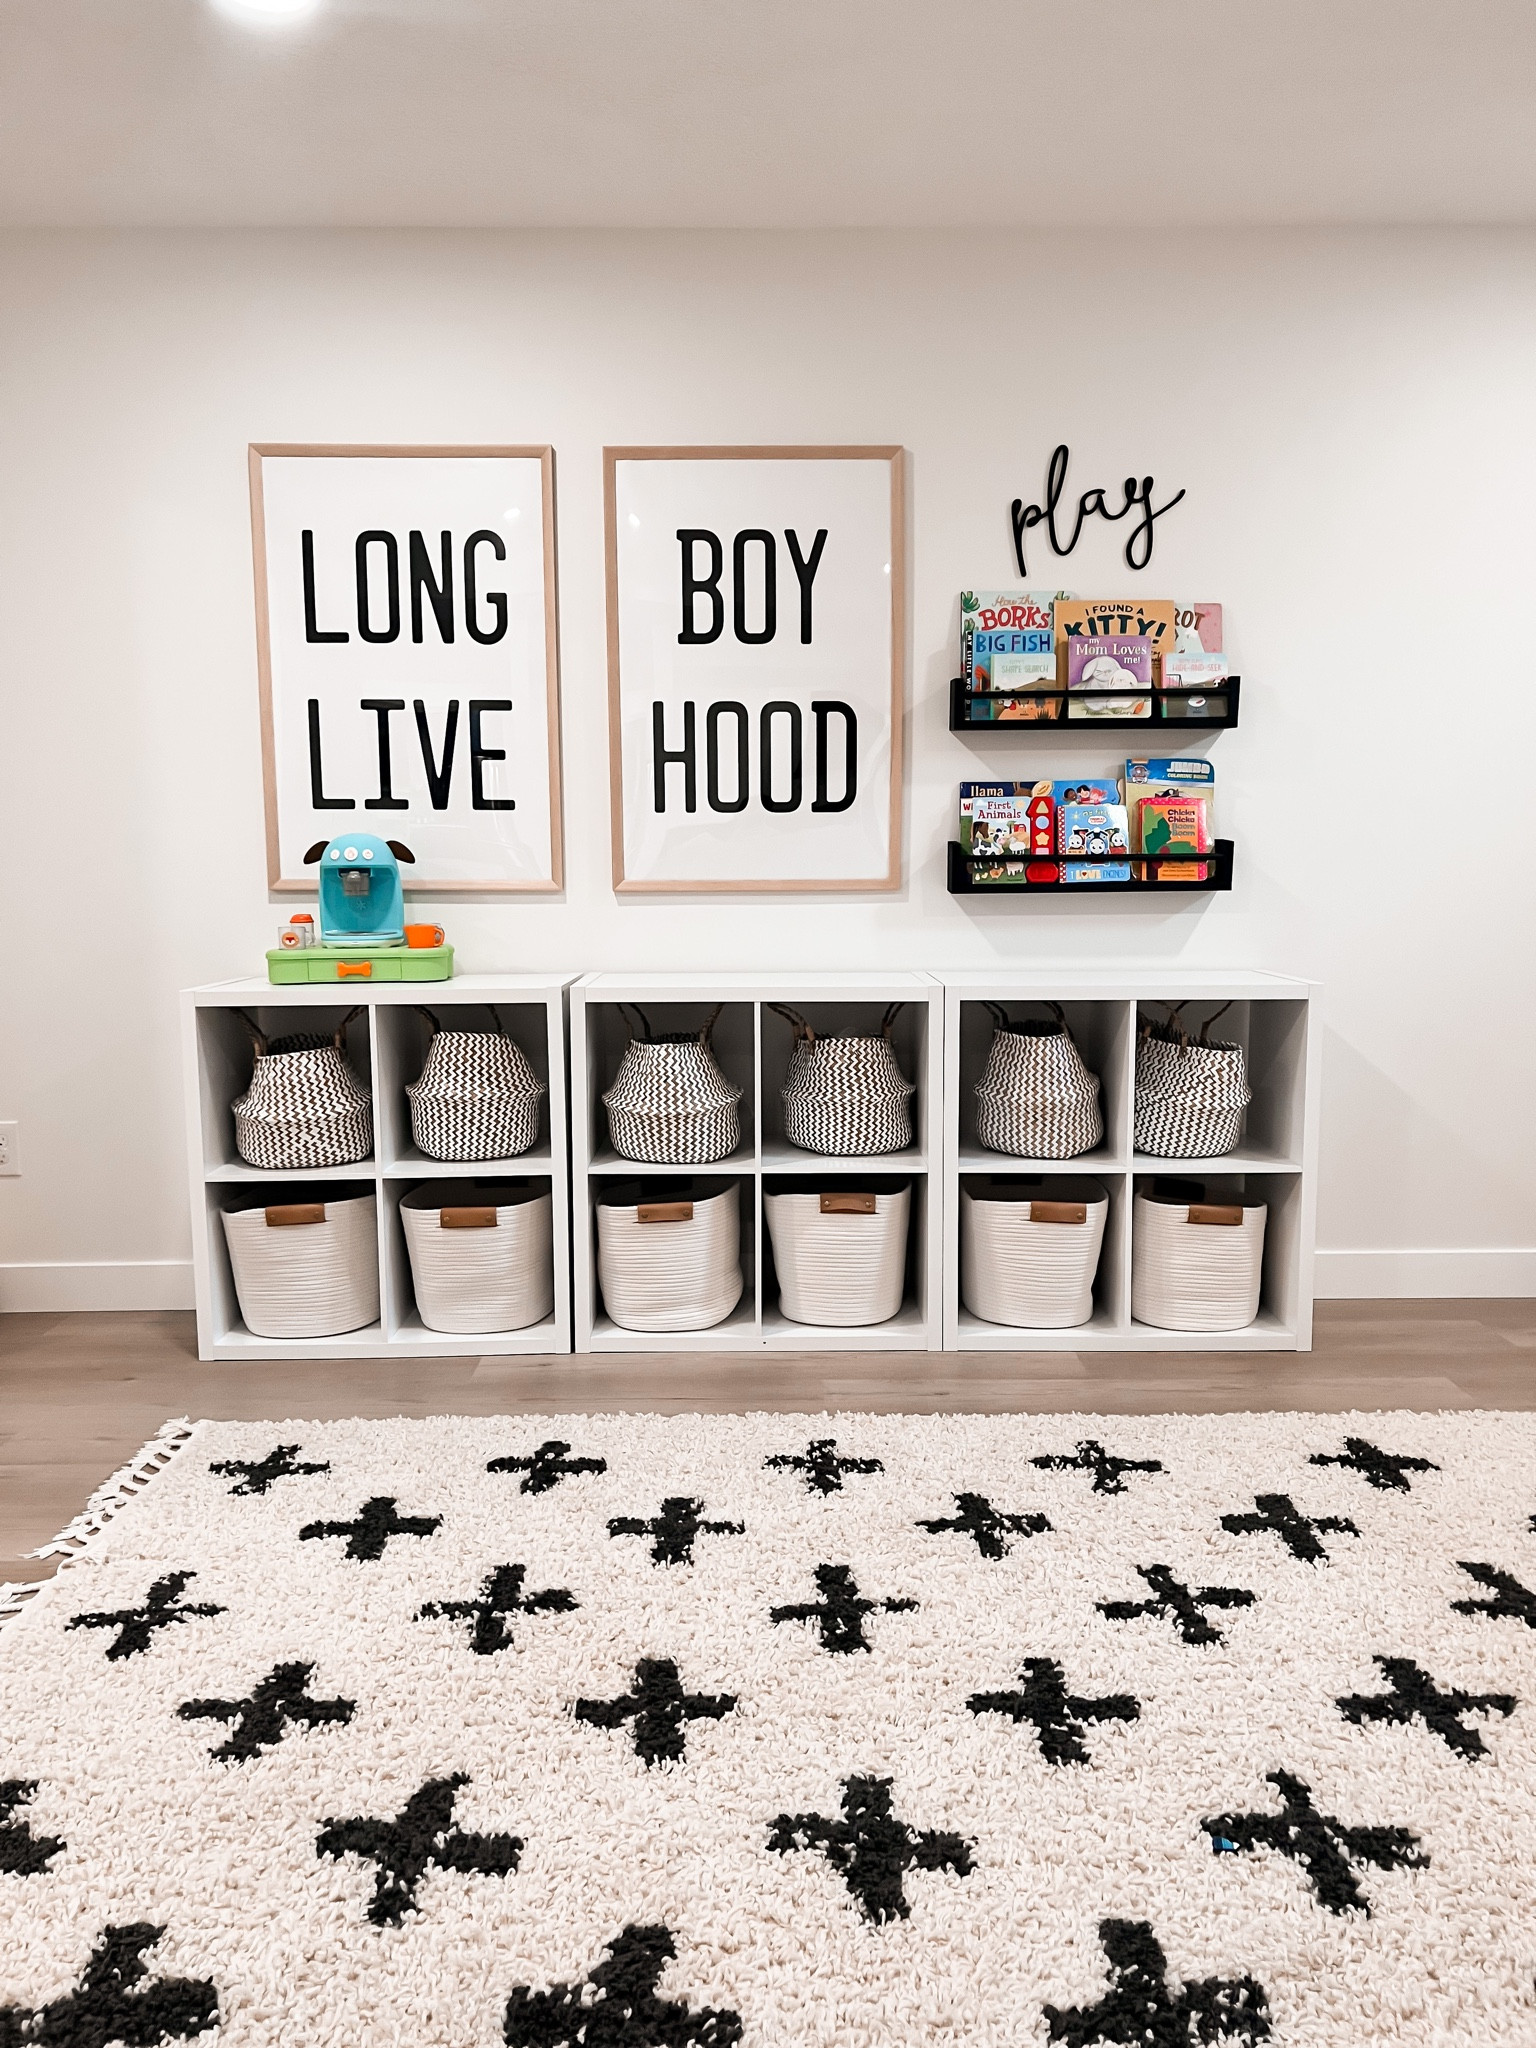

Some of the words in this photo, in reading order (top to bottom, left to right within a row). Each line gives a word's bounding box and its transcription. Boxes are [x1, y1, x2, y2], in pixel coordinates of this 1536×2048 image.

[1012, 444, 1186, 578] play
[302, 529, 508, 645] LONG
[676, 529, 828, 645] BOY
[1085, 608, 1089, 616] I
[1092, 604, 1133, 614] FOUND
[1064, 614, 1167, 644] KITTY!
[967, 634, 972, 645] MY
[976, 634, 1006, 652] BIG
[1011, 634, 1051, 652] FISH
[1089, 638, 1101, 646] my
[1076, 644, 1107, 655] Mom
[1113, 644, 1147, 655] Loves
[1123, 656, 1141, 664] me!
[307, 698, 516, 811] LIVE
[653, 701, 858, 813] HOOD
[971, 785, 1004, 797] llama
[987, 801, 1011, 810] First
[978, 809, 1022, 819] Animals
[1075, 869, 1101, 880] LOVE
